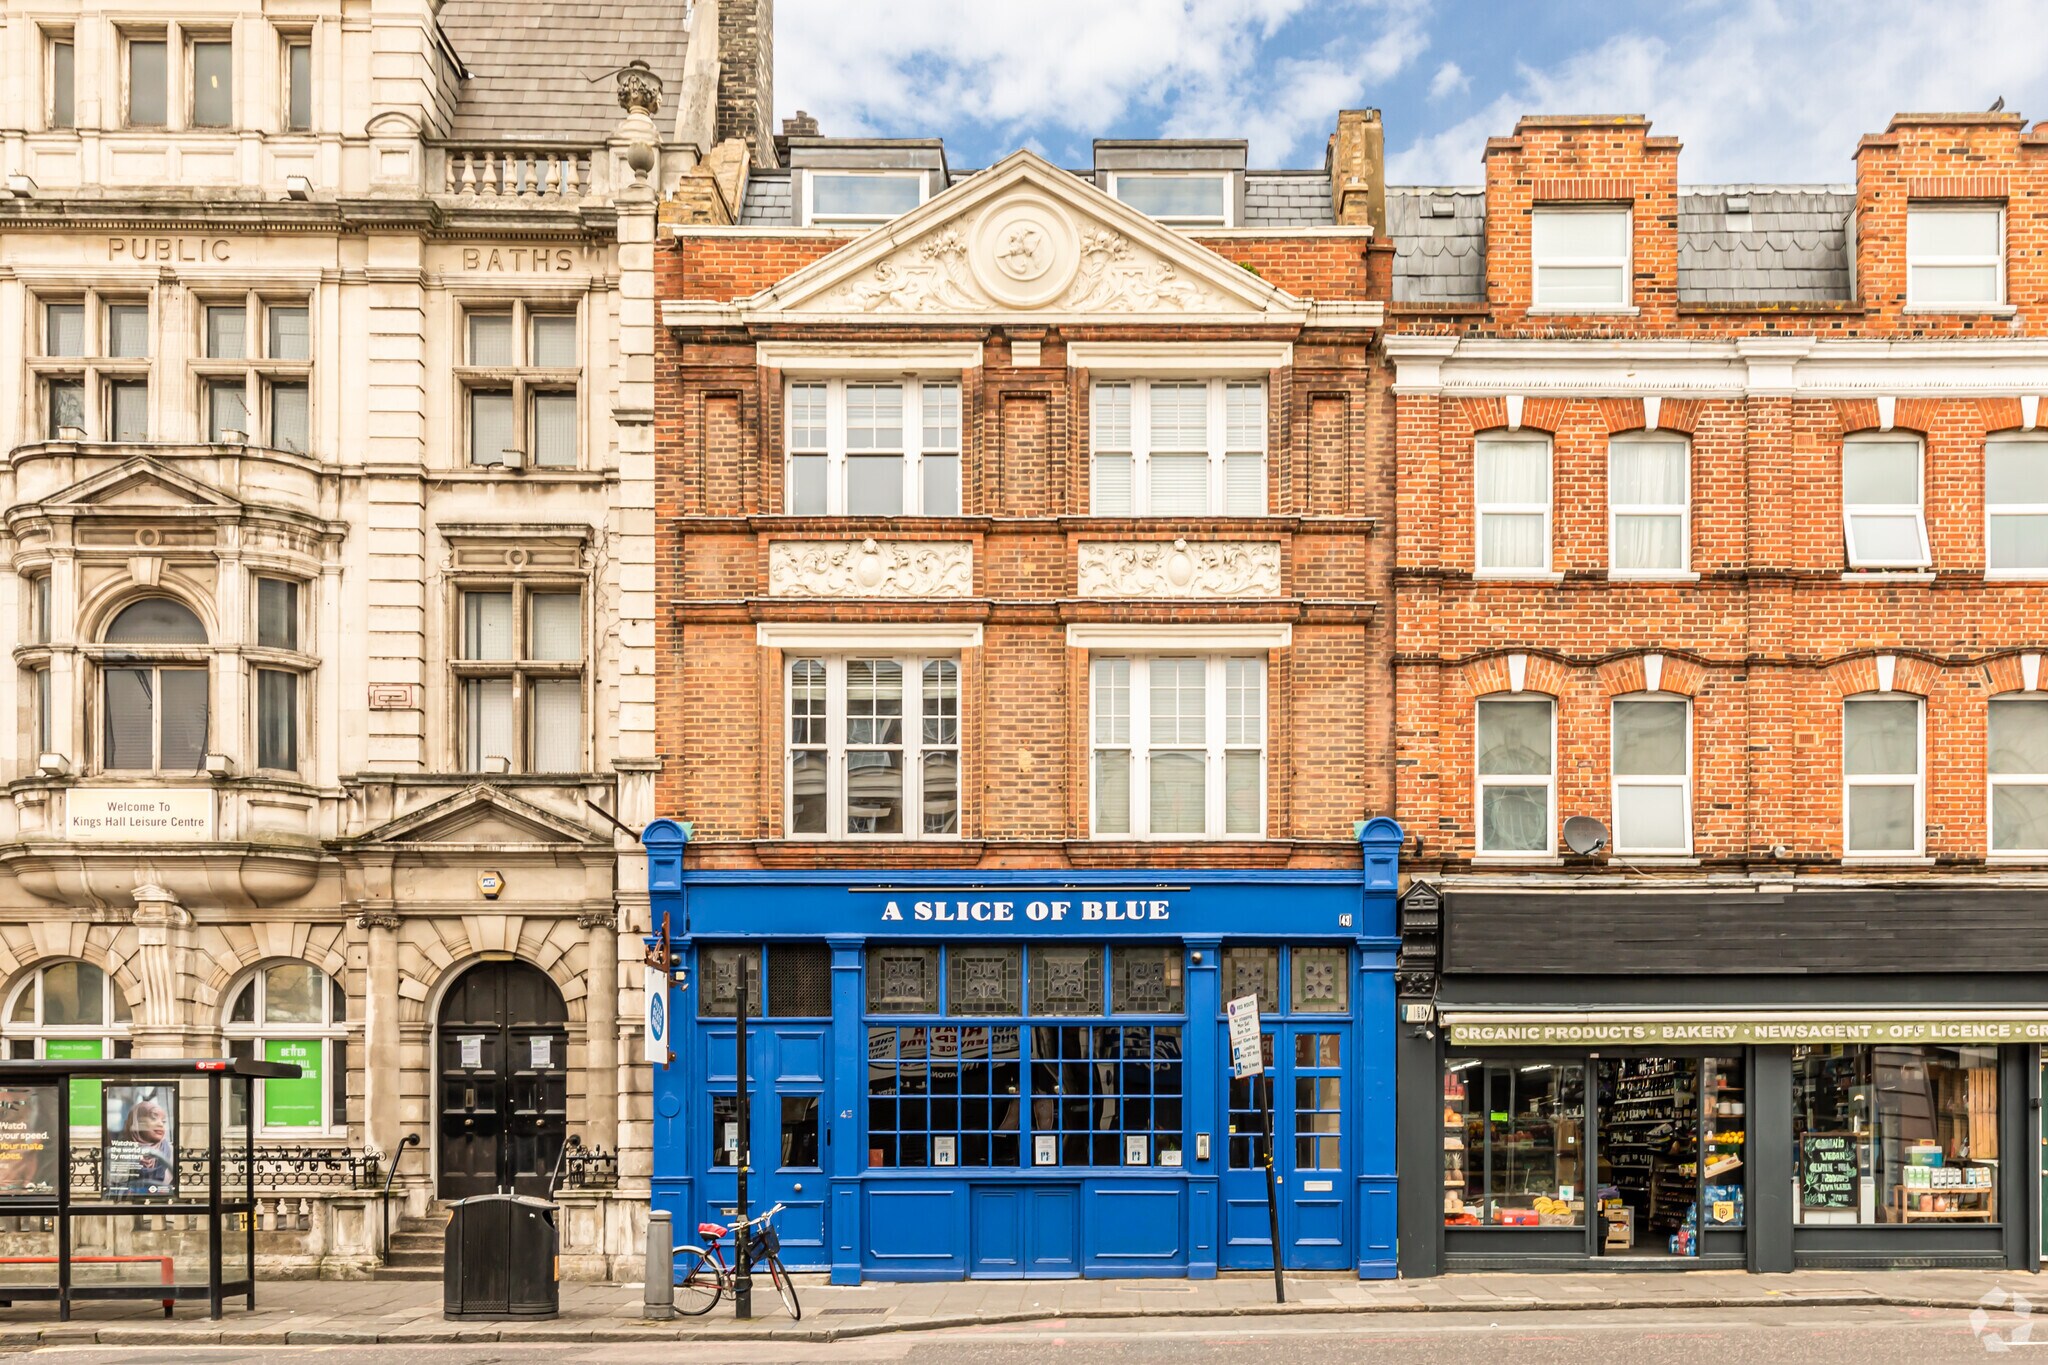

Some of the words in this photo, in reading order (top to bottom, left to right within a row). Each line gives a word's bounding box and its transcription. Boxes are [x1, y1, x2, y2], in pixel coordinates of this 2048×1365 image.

[108, 237, 231, 262] PUBLIC
[462, 248, 573, 272] BATHS
[107, 802, 155, 812] Welcome
[159, 802, 171, 812] To
[73, 817, 102, 828] Kings
[105, 817, 126, 827] Hall
[129, 817, 167, 827] Leisure
[171, 817, 205, 827] Centre
[881, 901, 904, 921] A
[914, 901, 1014, 921] SLICE
[1025, 901, 1071, 921] OF
[1081, 900, 1170, 920] BLUE
[1454, 1027, 1540, 1039] ORGANIC
[1544, 1026, 1646, 1040] PRODUCTS
[1662, 1026, 1738, 1038] BAKERY
[1754, 1025, 1872, 1038] NEWSAGENT
[1889, 1025, 1926, 1038] OFF
[1931, 1024, 2011, 1037] LICENCE
[281, 1044, 306, 1057] BETTER
[301, 1070, 317, 1078] NTRE
[0, 1121, 27, 1130] Watch
[20, 1131, 50, 1141] speed.
[111, 1140, 139, 1148] Watching
[1820, 1151, 1845, 1161] VEGAN
